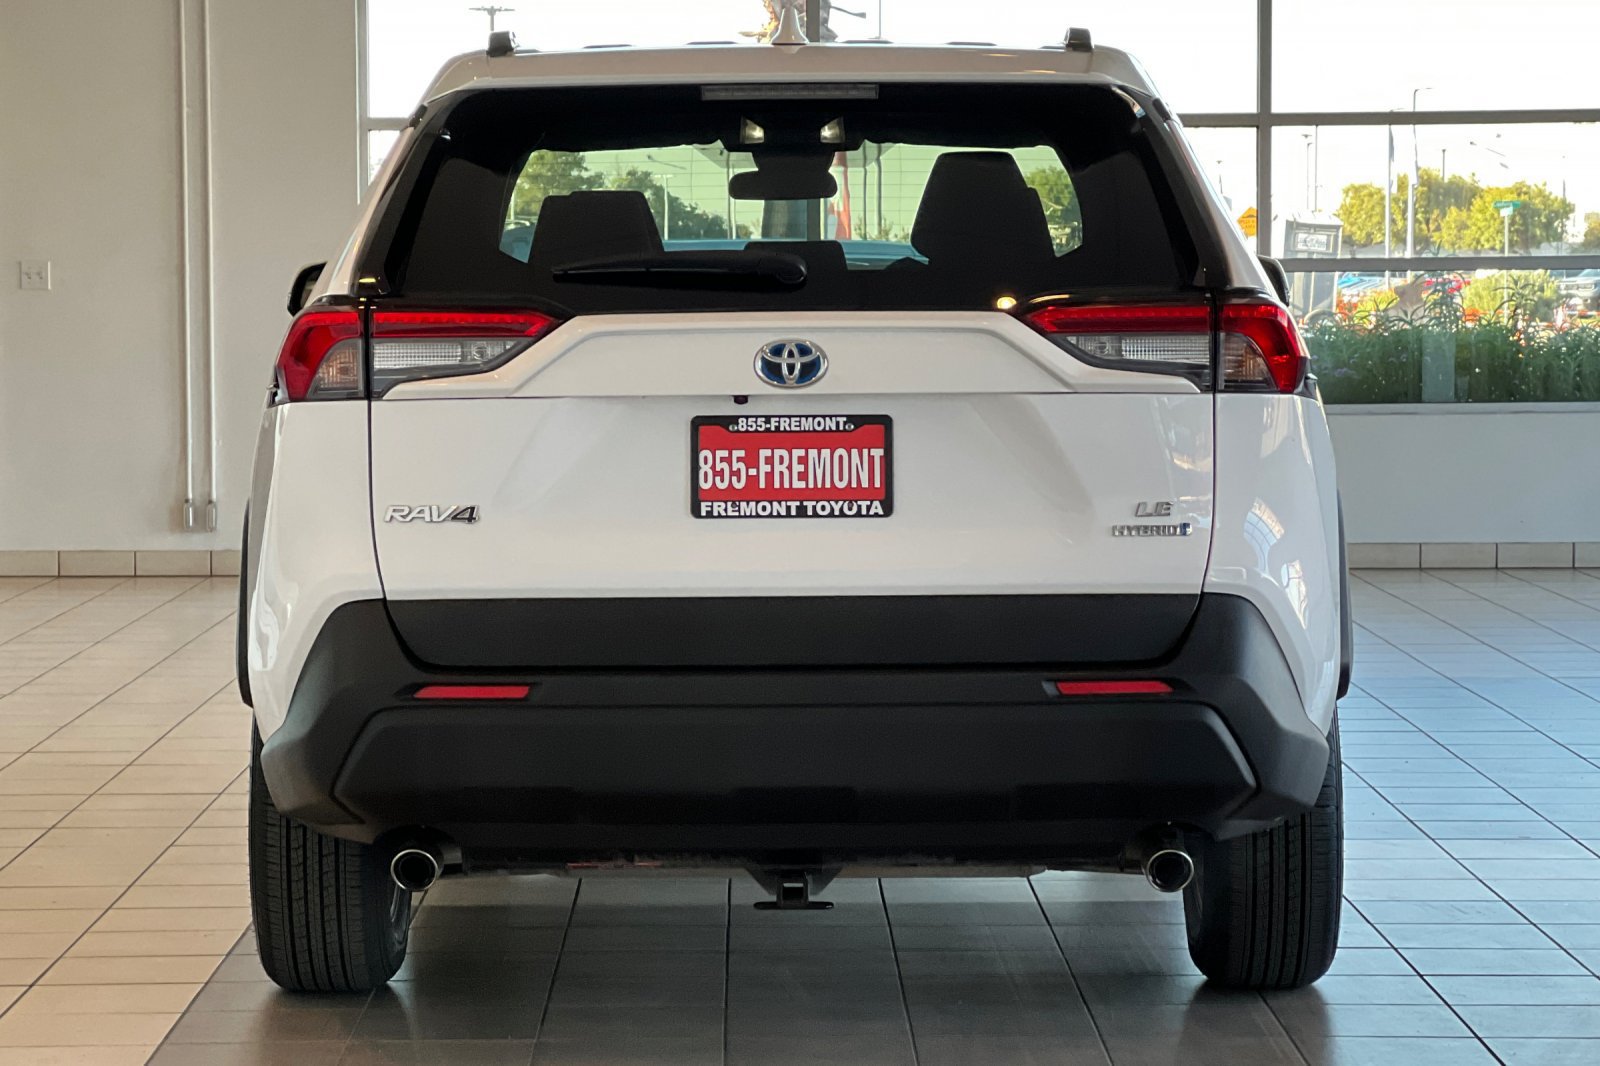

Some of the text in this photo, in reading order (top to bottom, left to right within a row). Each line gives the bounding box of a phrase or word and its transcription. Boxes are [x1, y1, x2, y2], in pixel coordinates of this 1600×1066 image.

[738, 417, 847, 431] 855-FREMONT
[698, 448, 885, 490] 855-FREMONT
[384, 505, 480, 524] RAV4
[700, 501, 884, 516] FREMONT TOYOTA
[1135, 501, 1172, 517] LE
[1111, 525, 1181, 537] HYBRID
